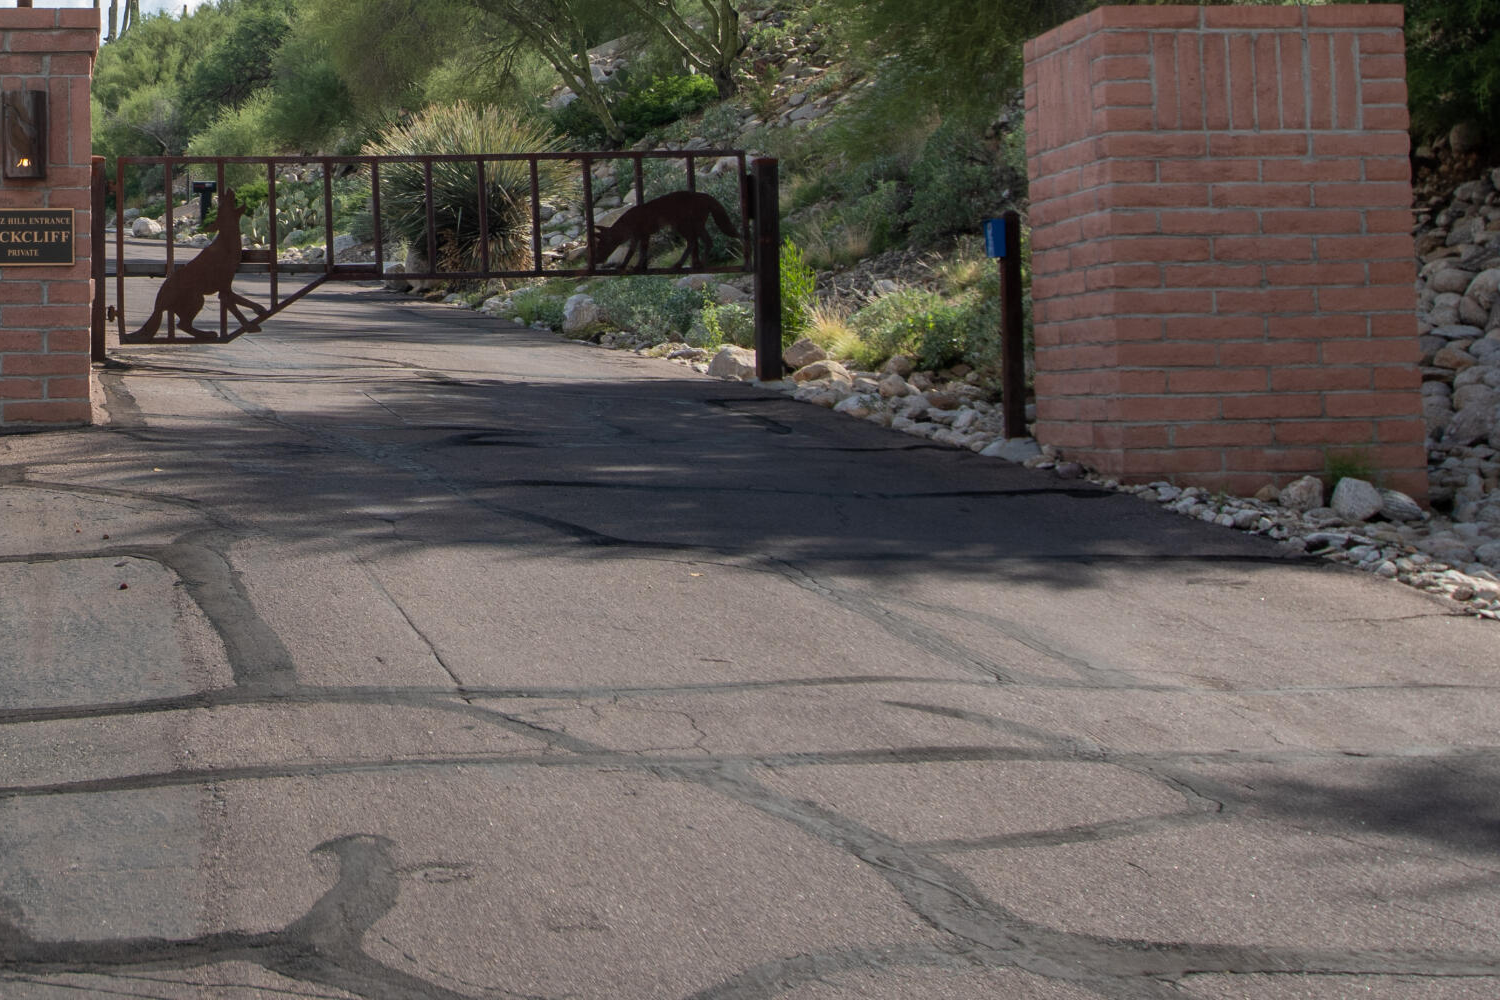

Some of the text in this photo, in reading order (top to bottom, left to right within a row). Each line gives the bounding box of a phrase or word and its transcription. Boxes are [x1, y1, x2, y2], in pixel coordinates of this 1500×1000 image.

[8, 217, 27, 225] HILL
[29, 217, 71, 225] ENTRANCE
[7, 249, 39, 257] PRIVATE
